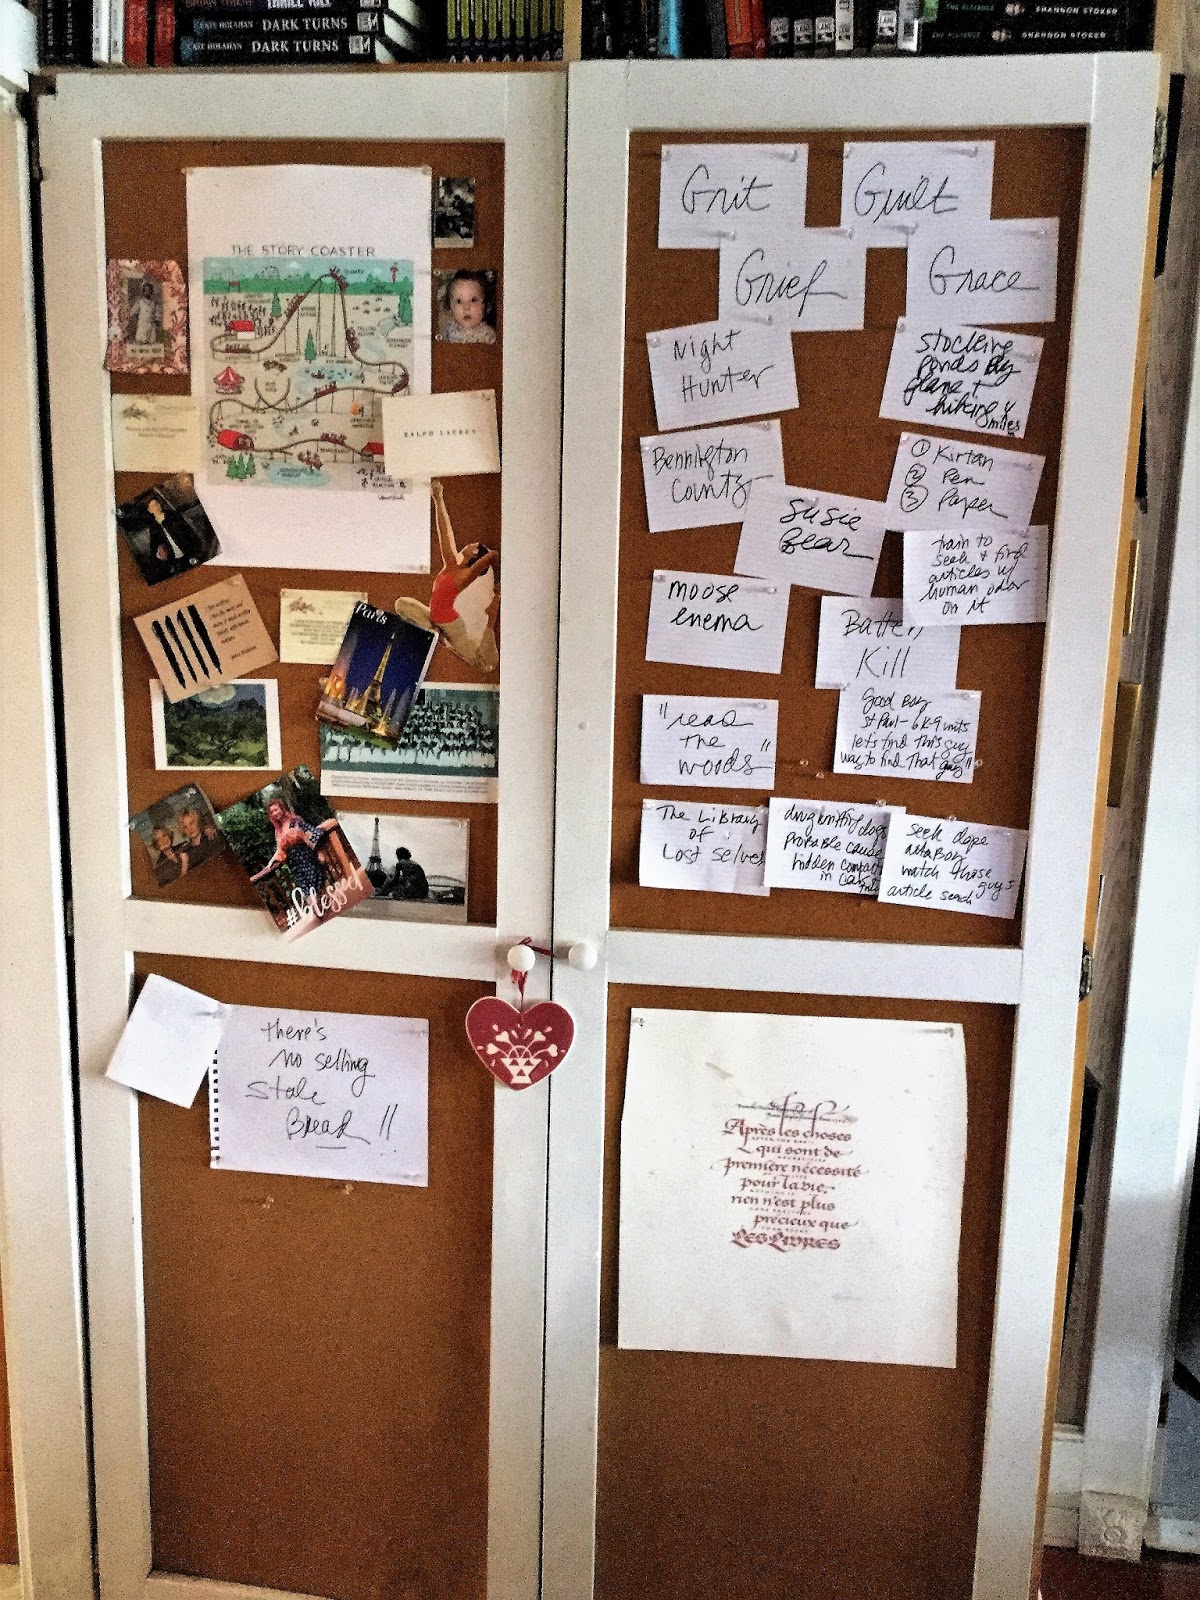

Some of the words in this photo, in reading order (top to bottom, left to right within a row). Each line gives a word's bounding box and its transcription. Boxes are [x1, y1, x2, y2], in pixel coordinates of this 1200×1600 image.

[262, 18, 300, 32] DARK
[302, 17, 348, 31] TURNS
[252, 40, 289, 53] DARK
[293, 39, 339, 52] TURNS
[682, 164, 773, 215] Grit
[854, 161, 959, 223] Guilt
[232, 244, 255, 257] THE
[261, 244, 302, 257] STORY
[310, 245, 376, 257] COASTER
[929, 245, 1040, 295] Grace
[735, 248, 848, 317] Grief
[674, 329, 742, 374] Night
[681, 364, 774, 403] Hunter
[976, 533, 993, 548] to
[355, 602, 388, 625] Paris
[670, 607, 764, 632] enema
[856, 646, 911, 678] Kill
[656, 804, 690, 821] The
[689, 826, 714, 842] of
[268, 1049, 302, 1068] no
[755, 1144, 782, 1158] qui
[785, 1146, 822, 1157] sont
[823, 1146, 853, 1158] de
[740, 1177, 779, 1191] pour
[775, 1174, 800, 1190] la
[731, 1195, 759, 1206] rien
[800, 1195, 836, 1215] plus
[819, 1218, 858, 1232] que
